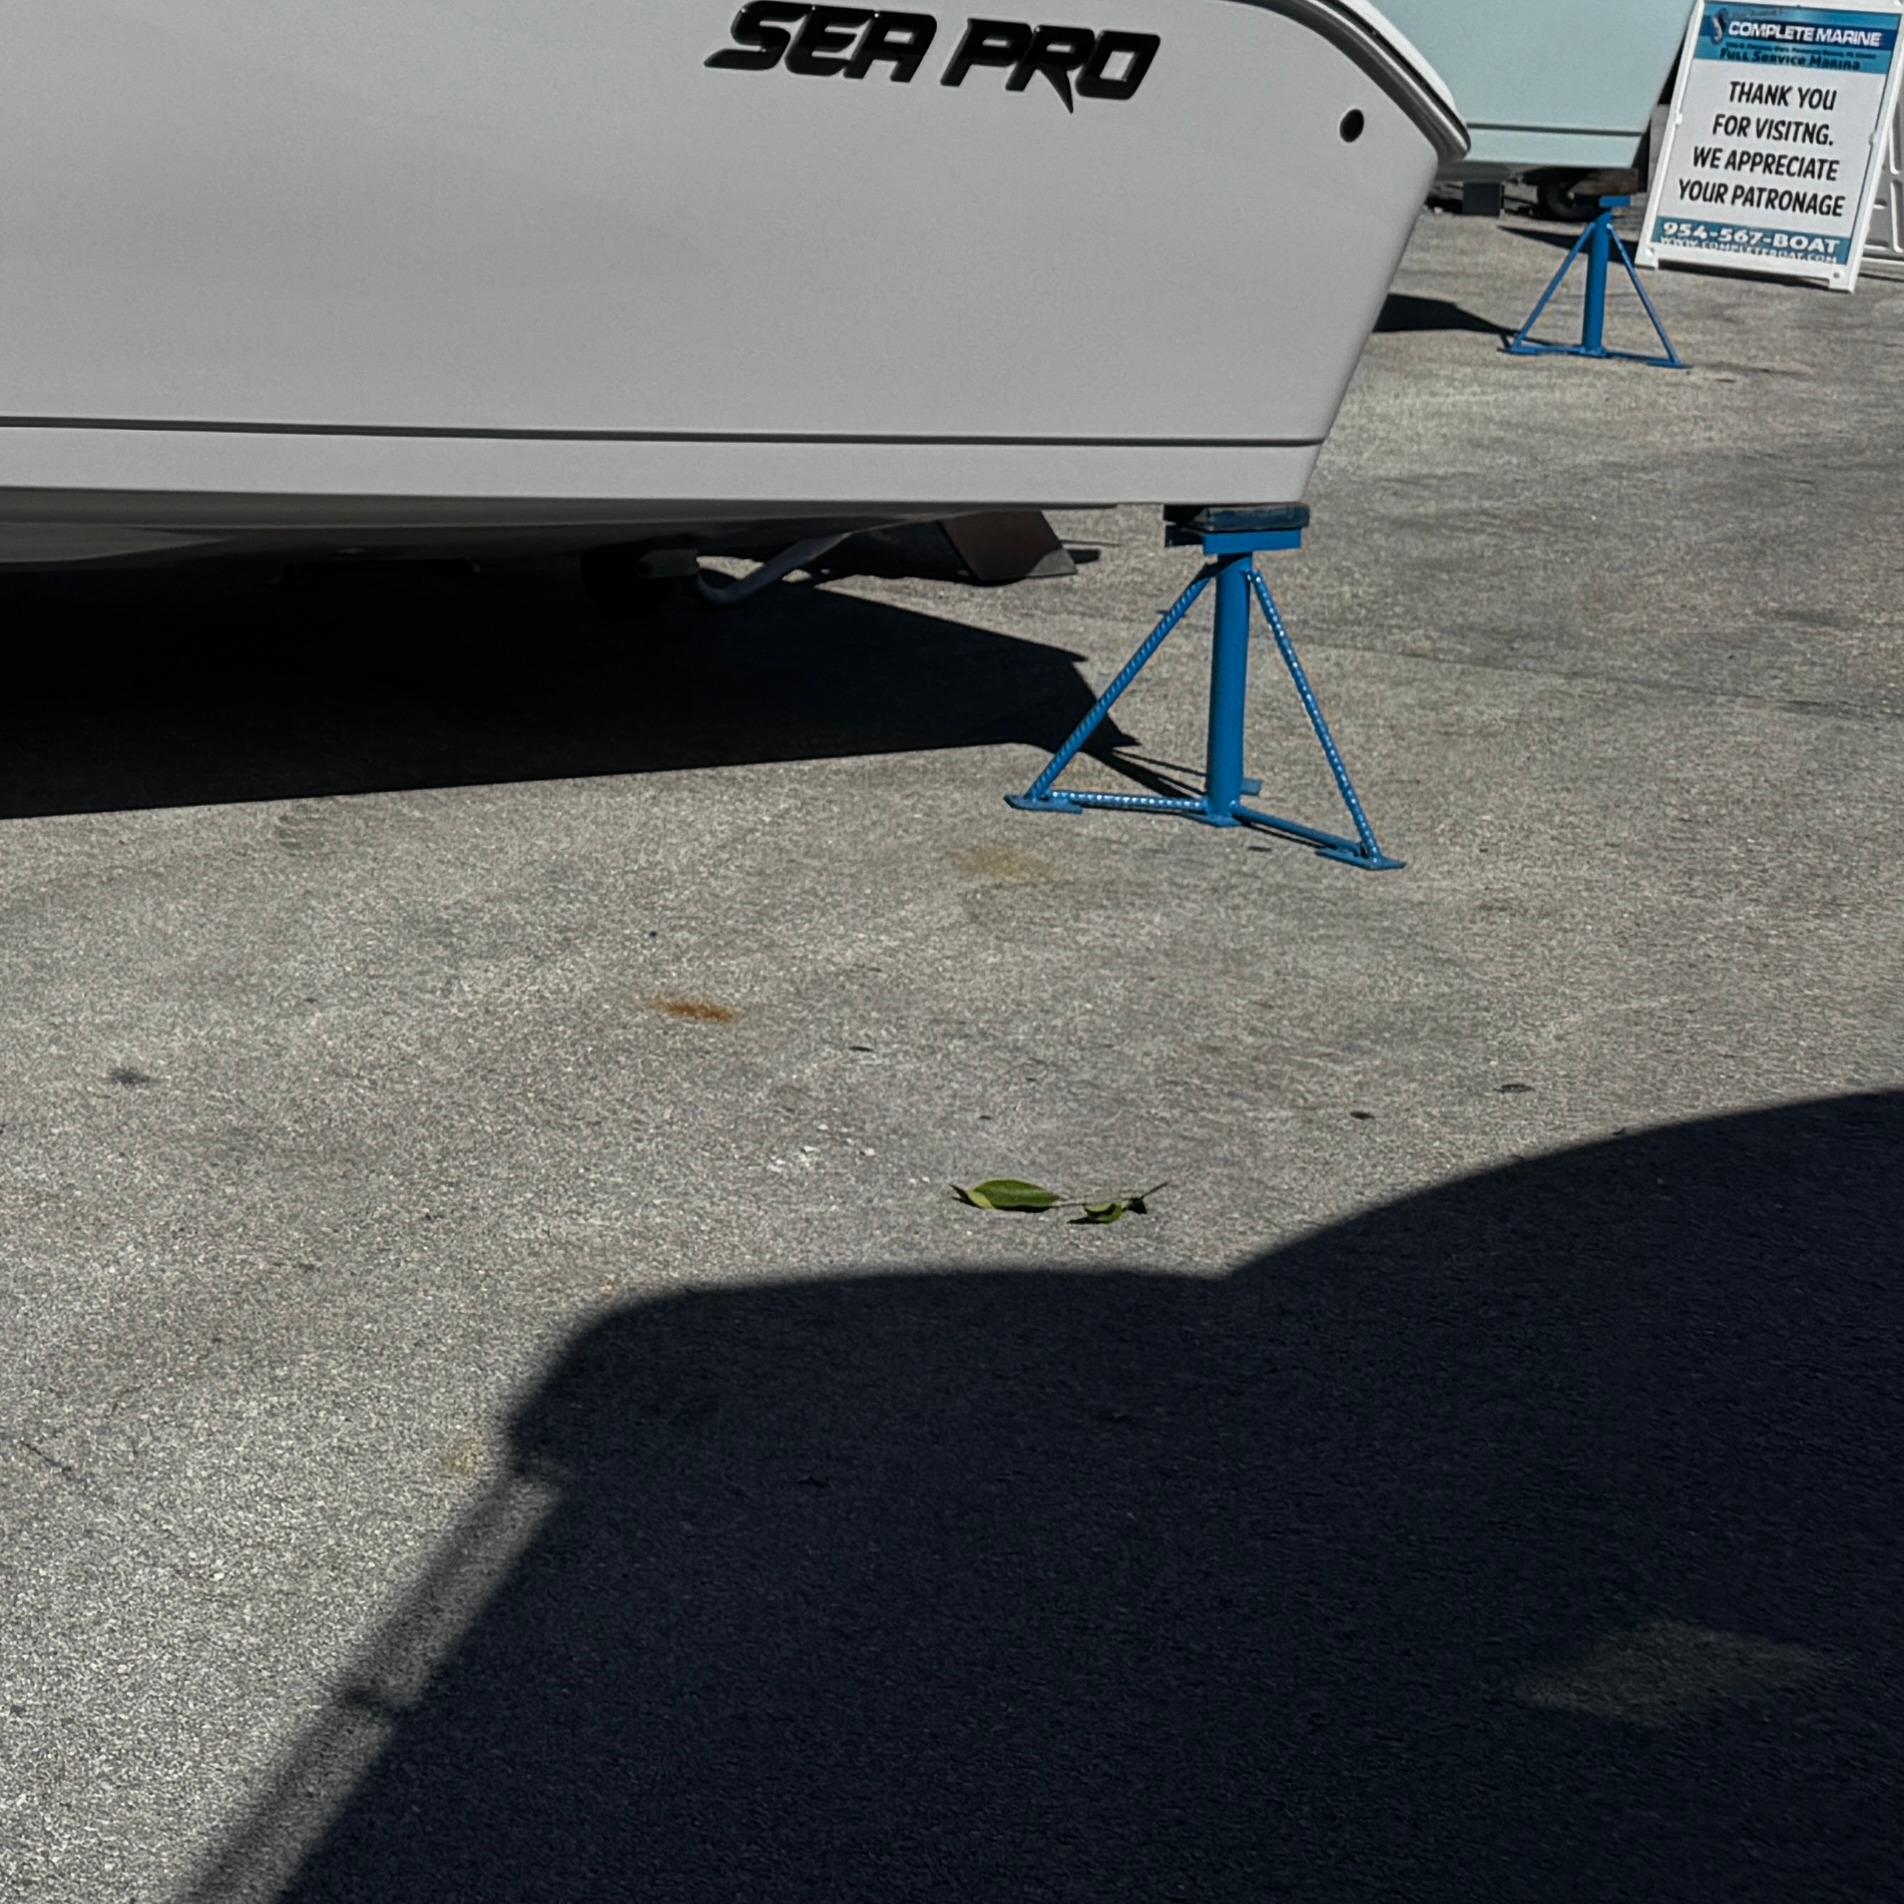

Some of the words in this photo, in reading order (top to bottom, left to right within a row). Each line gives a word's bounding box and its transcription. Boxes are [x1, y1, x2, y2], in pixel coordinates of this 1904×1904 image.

[1728, 21, 1815, 42] COMPLETE
[1814, 27, 1883, 47] MARINE
[703, 0, 938, 83] SEA
[939, 17, 1161, 114] PRO
[1729, 81, 1793, 107] THANK
[1797, 87, 1838, 111] YOU
[1712, 113, 1751, 138] FOR
[1755, 116, 1834, 146] VISITNG.
[1692, 146, 1722, 171] WE
[1724, 151, 1840, 182] APPRECIATE
[1678, 179, 1730, 204] YOUR
[1730, 184, 1846, 217] PATRONAGE
[1663, 221, 1841, 254] 954-567-BOAT
